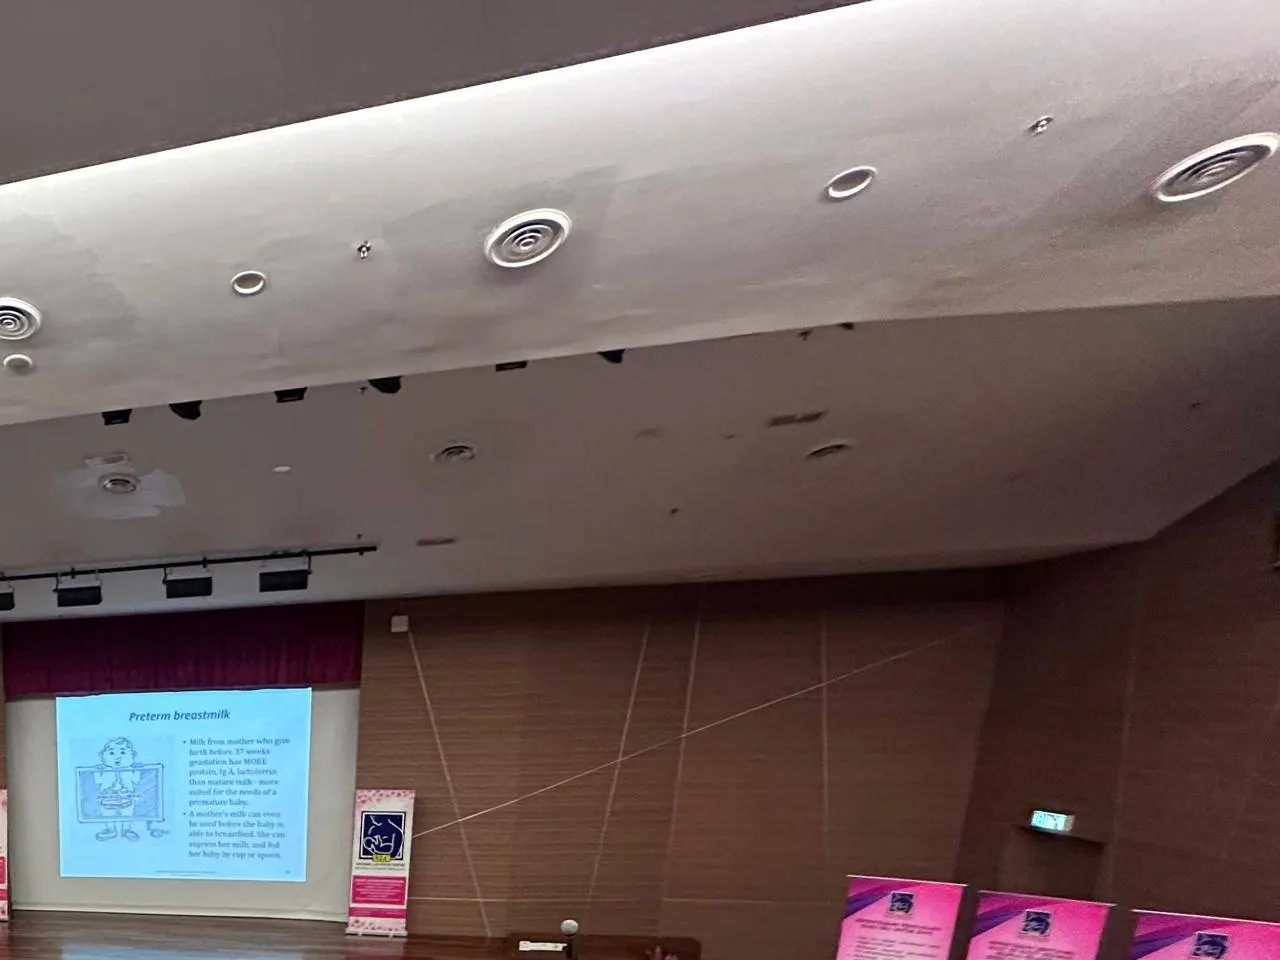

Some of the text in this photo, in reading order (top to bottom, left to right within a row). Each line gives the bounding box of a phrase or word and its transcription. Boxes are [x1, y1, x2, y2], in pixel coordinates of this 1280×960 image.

[129, 710, 230, 721] Preterm breastmilk
[190, 748, 208, 756] birth
[209, 748, 233, 756] before
[246, 748, 270, 756] weeks
[228, 758, 242, 766] has
[244, 758, 268, 766] MORE
[190, 788, 211, 796] suited
[212, 788, 224, 796] for
[226, 788, 238, 796] the
[240, 788, 261, 796] needs
[262, 788, 271, 796] of
[190, 799, 228, 807] premature
[230, 810, 246, 818] milk
[248, 810, 261, 818] can
[189, 820, 198, 828] be
[200, 820, 216, 828] used
[218, 820, 241, 828] before
[243, 820, 256, 828] the
[257, 820, 275, 828] baby
[189, 830, 204, 838] able
[206, 830, 214, 838] to
[256, 830, 270, 838] She
[272, 830, 286, 838] can
[189, 841, 216, 849] express
[218, 841, 230, 849] her
[252, 841, 266, 849] and
[189, 851, 201, 860] her
[202, 851, 220, 860] baby
[222, 851, 231, 860] by
[232, 851, 246, 860] cup
